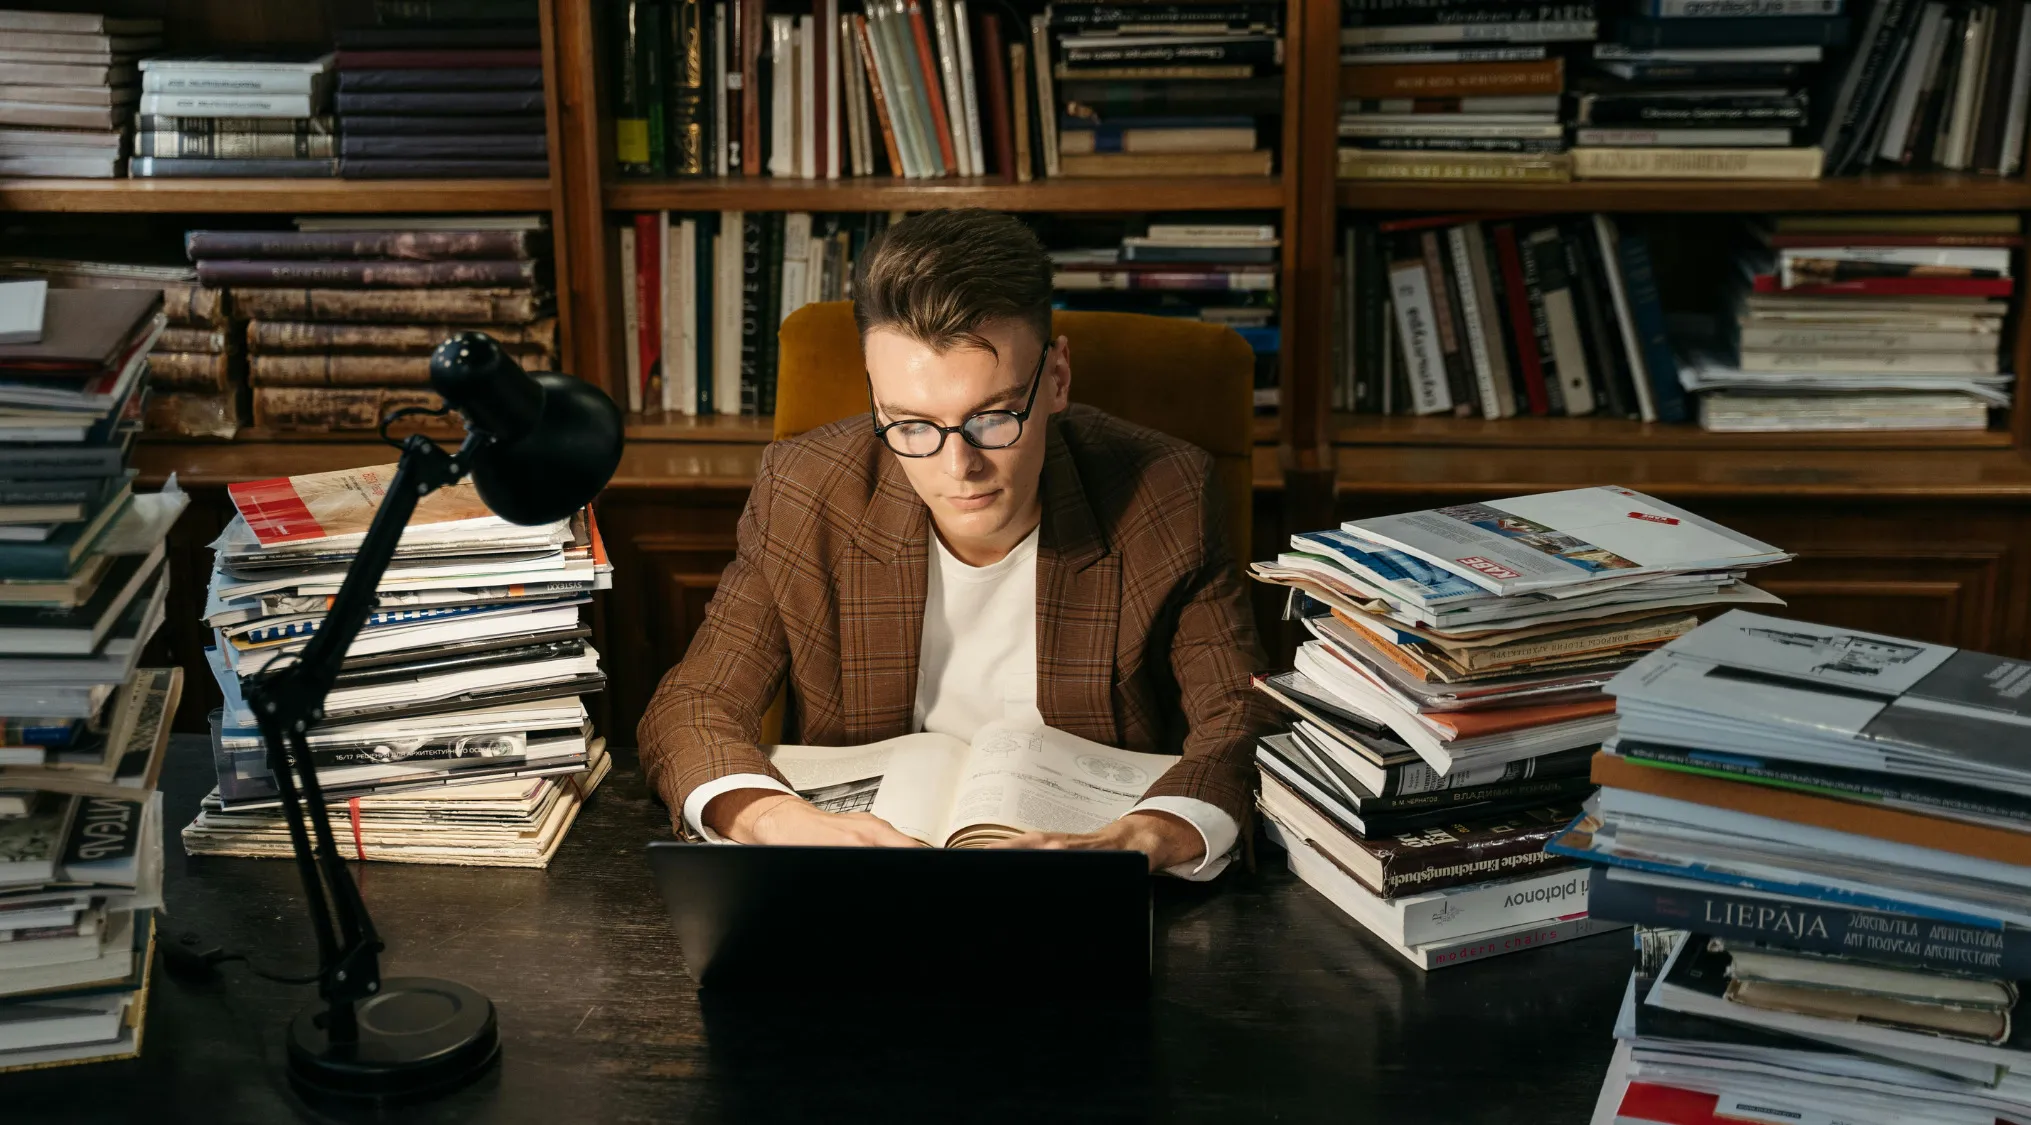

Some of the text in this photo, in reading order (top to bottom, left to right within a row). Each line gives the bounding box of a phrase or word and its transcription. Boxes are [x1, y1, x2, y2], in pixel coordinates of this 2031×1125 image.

[1538, 5, 1594, 20] PARIS
[1458, 557, 1518, 579] KABE
[547, 581, 583, 591] SYSTEXXI
[1551, 640, 1584, 651] ТЕОРИИ
[1588, 634, 1629, 647] ВОПРОСЫ
[405, 747, 468, 757] АРХИТЕКТУРНО
[1390, 858, 1499, 887] Einrichtungsbuch
[1503, 878, 1576, 908] platonov
[1705, 900, 1829, 939] LIEPĀJA
[1435, 929, 1558, 965] modern chairs
[1844, 932, 2003, 966] ART NOUVEAU ARCHITECTURE
